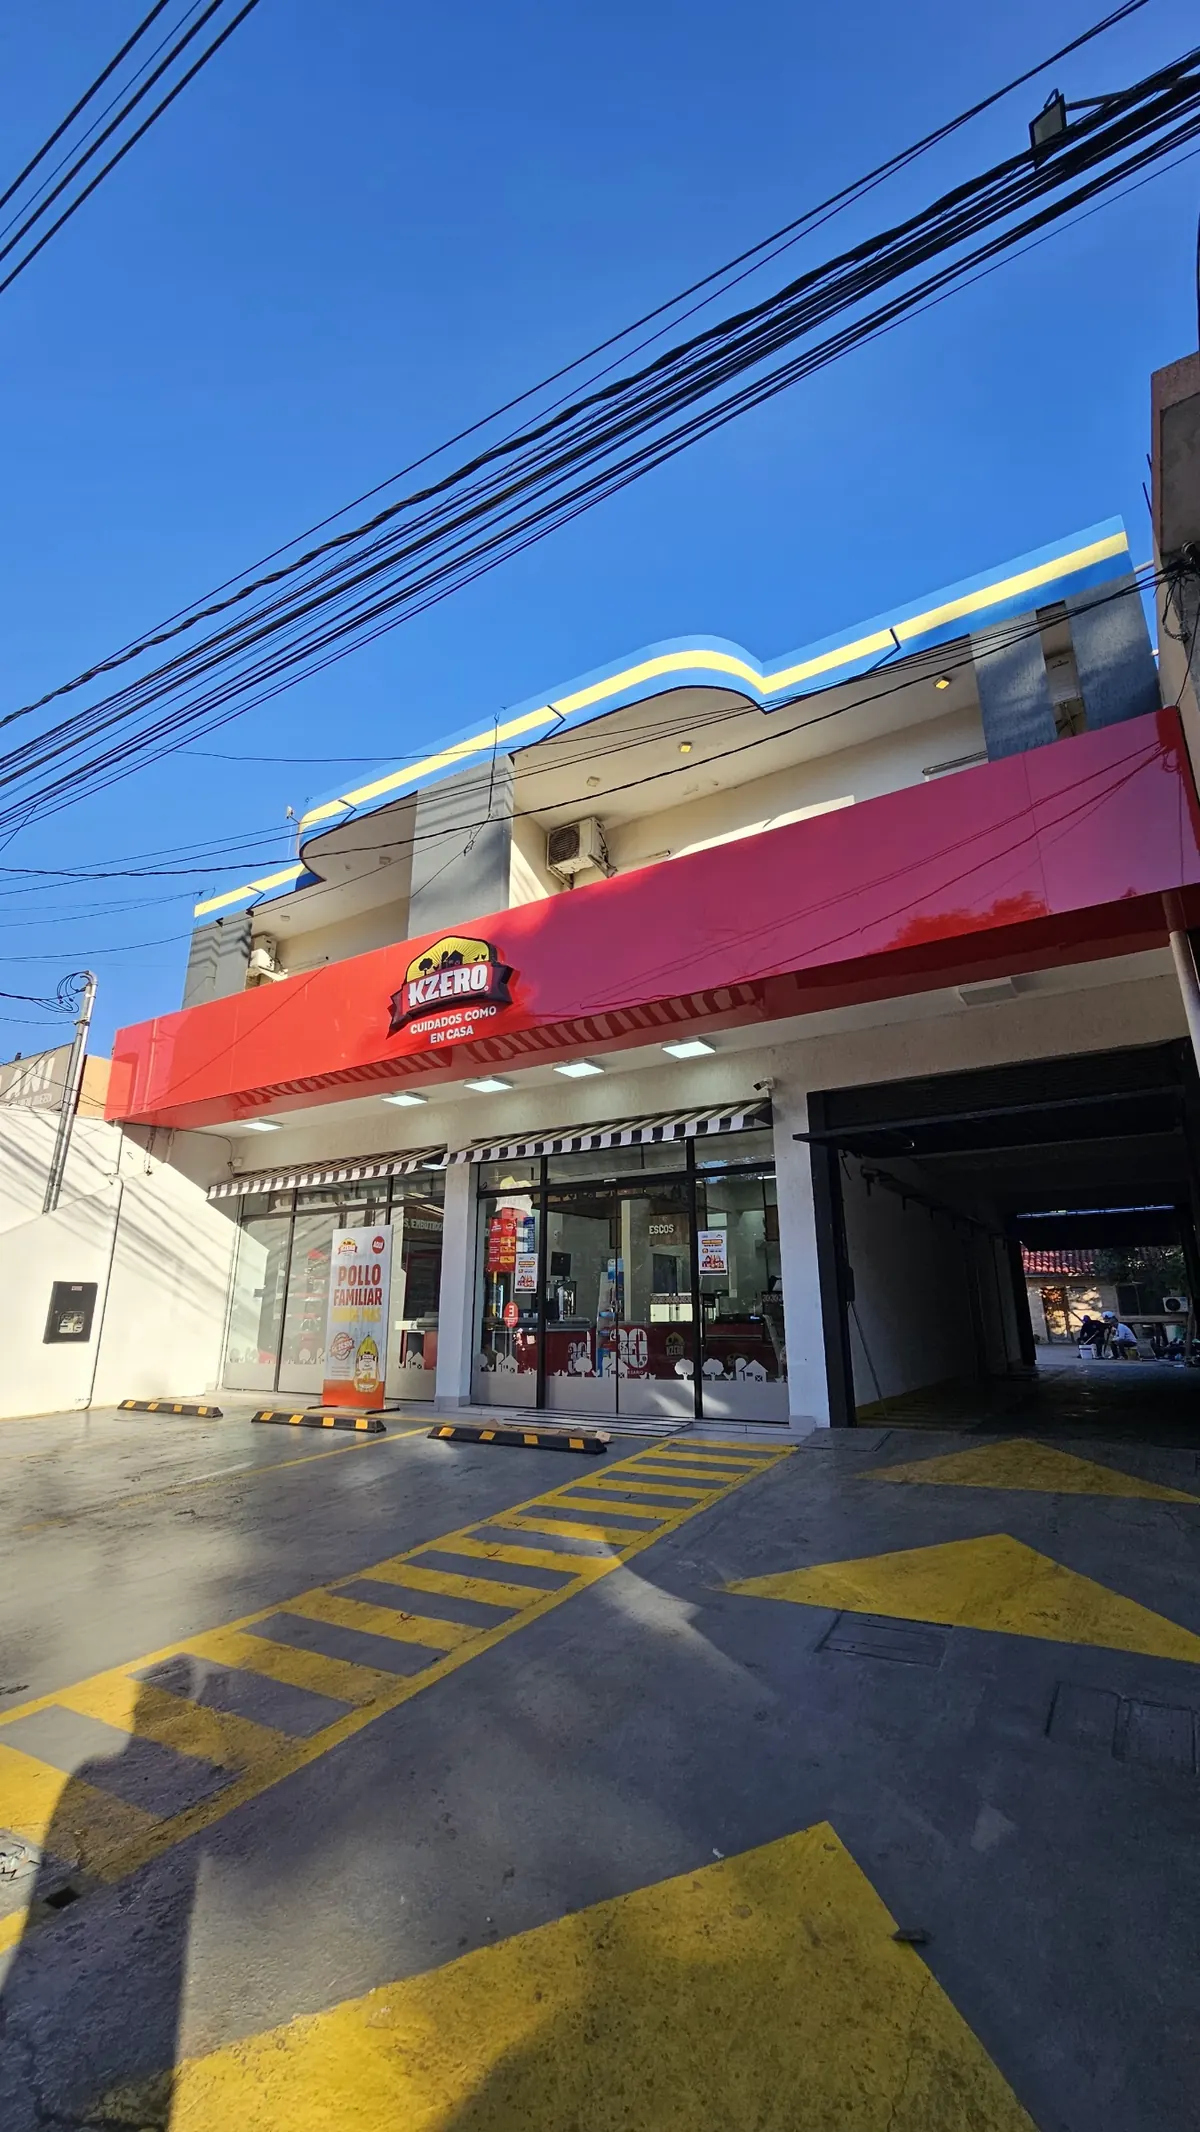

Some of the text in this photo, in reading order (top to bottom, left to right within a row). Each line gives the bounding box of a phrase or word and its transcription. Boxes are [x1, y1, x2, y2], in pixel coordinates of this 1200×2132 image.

[408, 964, 488, 1007] KZERO
[410, 1006, 497, 1035] CUIDADOS COMO
[430, 1025, 474, 1044] EN CASA
[0, 1057, 55, 1100] ANI
[649, 1224, 674, 1235] ESCOS
[338, 1263, 382, 1287] POLLO
[333, 1287, 382, 1307] FAMILIAR
